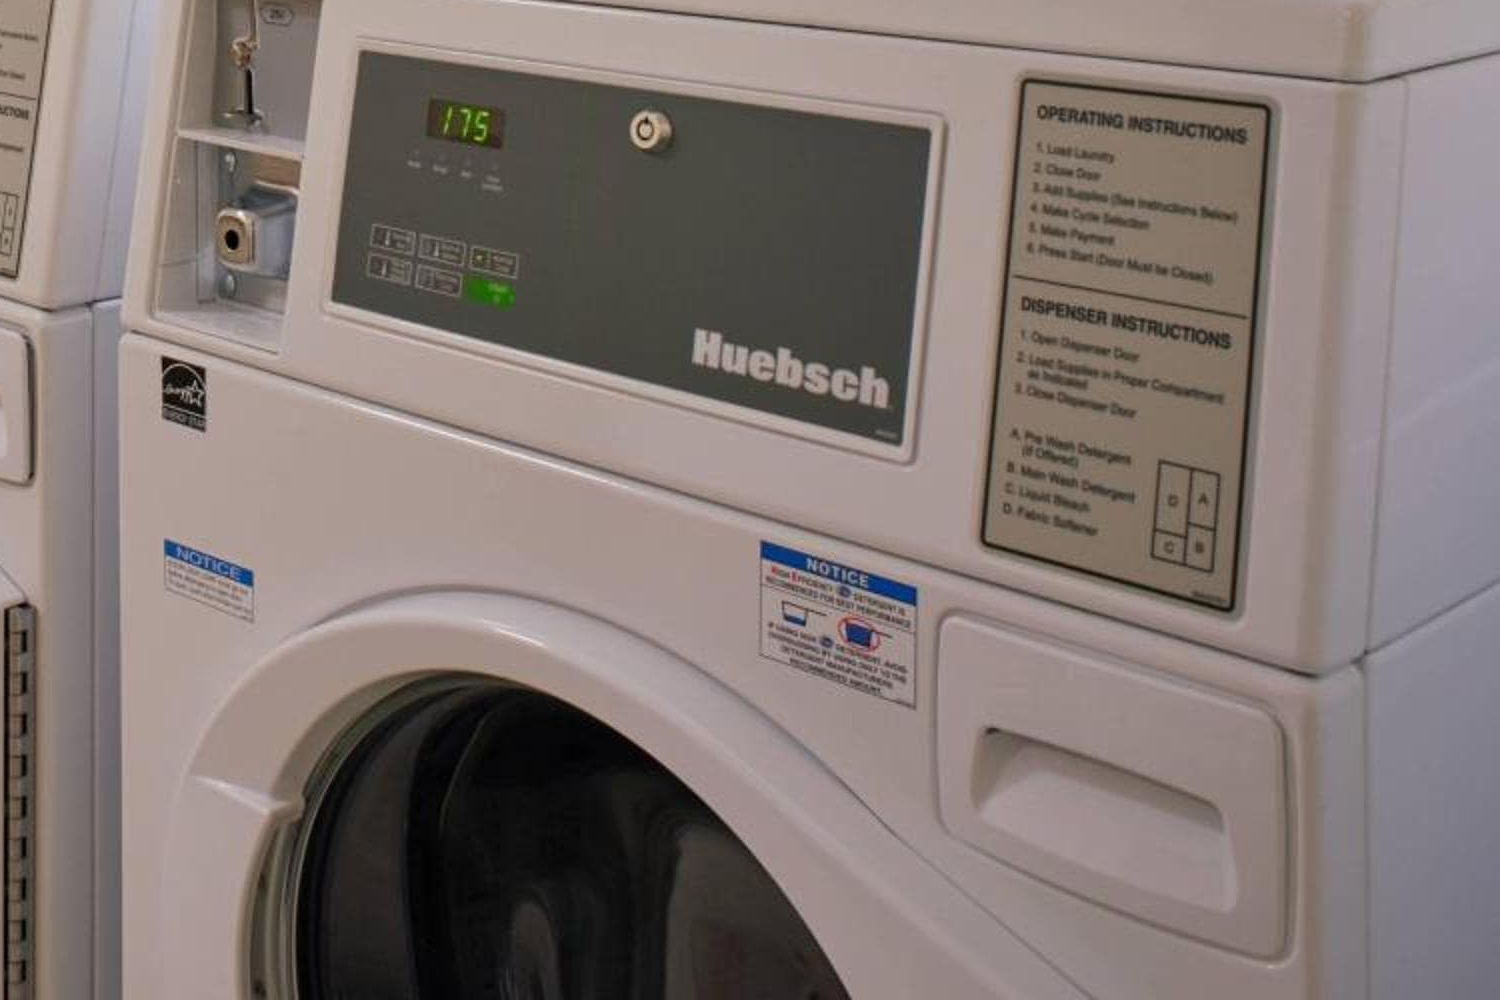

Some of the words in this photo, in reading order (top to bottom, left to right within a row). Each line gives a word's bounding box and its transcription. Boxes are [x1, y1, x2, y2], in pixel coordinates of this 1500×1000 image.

[1036, 104, 1125, 130] OPERATING
[1127, 113, 1248, 145] INSTRUCTIONS
[1020, 295, 1108, 326] DISPENSER
[1111, 312, 1232, 350] INSTRUCTIONS
[691, 327, 890, 410] Huebsch
[176, 545, 241, 581] NOTICE
[806, 557, 869, 588] NOTICE
